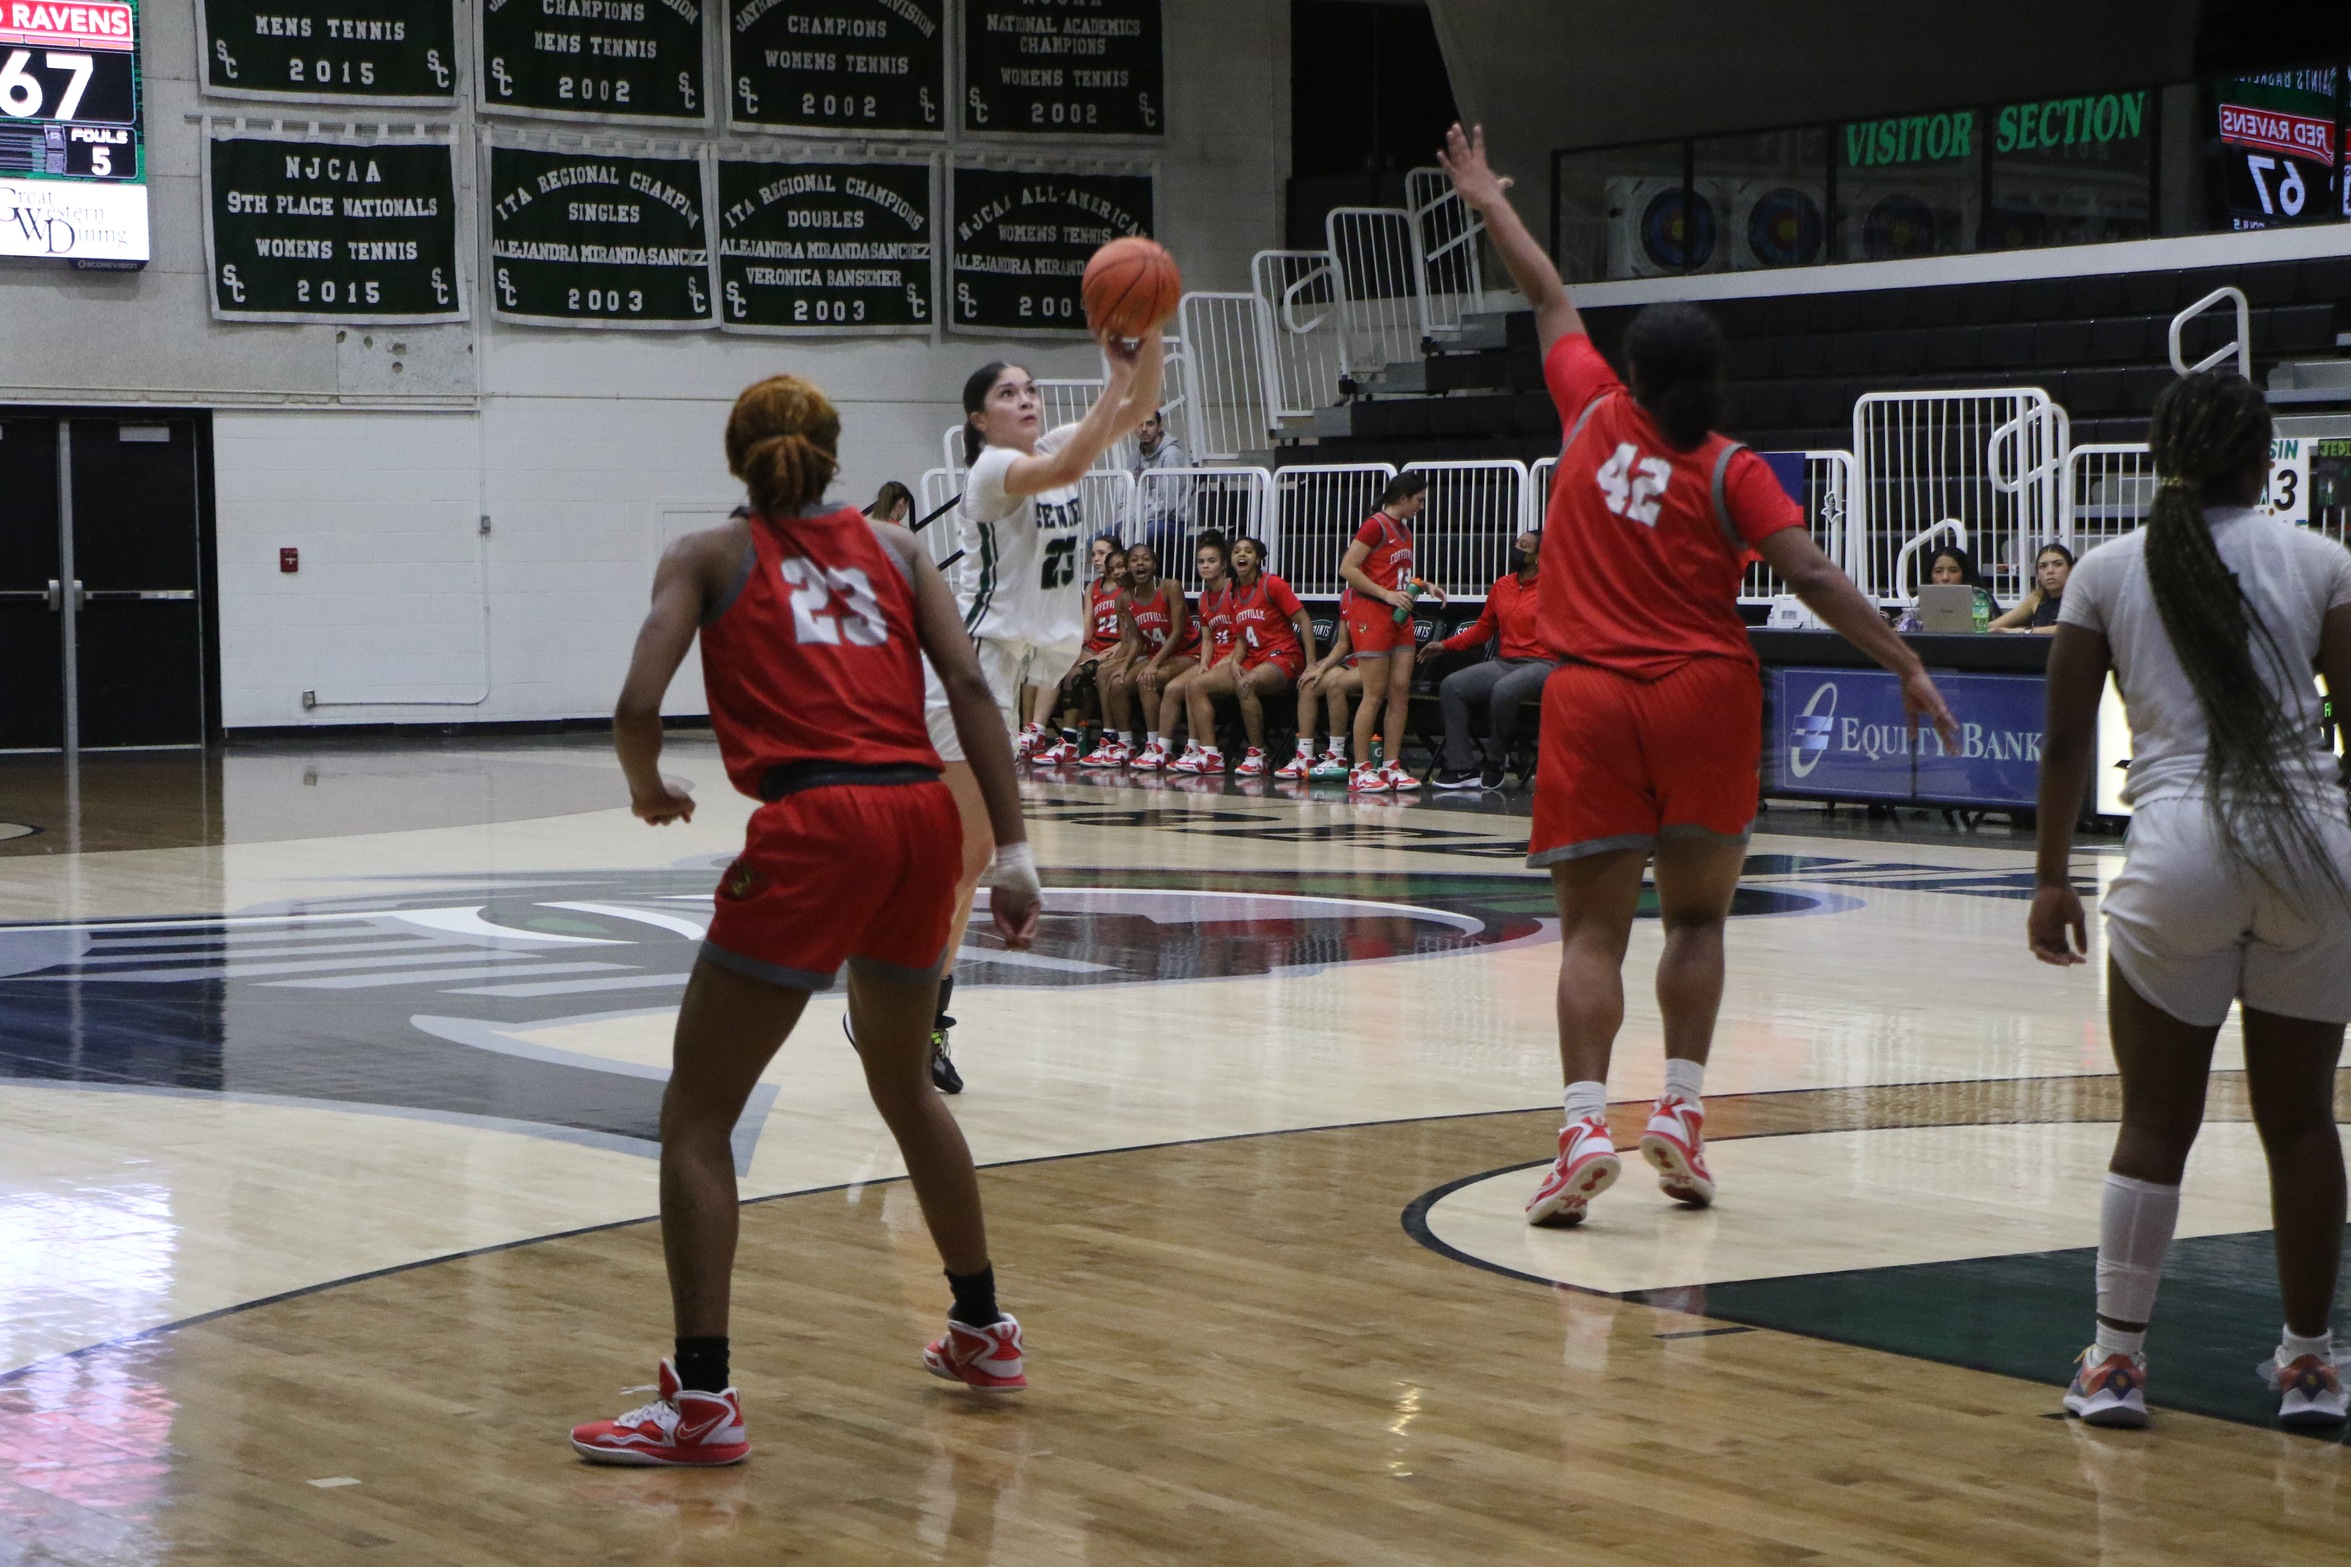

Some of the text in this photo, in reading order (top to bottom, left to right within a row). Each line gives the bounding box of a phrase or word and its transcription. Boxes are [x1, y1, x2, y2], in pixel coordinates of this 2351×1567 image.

[12, 3, 128, 35] RAVENS
[542, 0, 645, 22] CHAMPIONS
[255, 15, 405, 41] MENS TENNIS
[787, 15, 887, 38] CHAMPIONS
[986, 14, 1141, 37] NATIONAL ACADEMICS
[534, 30, 657, 59] MENS TENNIS
[1020, 36, 1106, 55] CHAMPIONS
[289, 58, 375, 85] 2015
[764, 50, 909, 75] WOMENS TENNIS
[0, 50, 93, 120] 67
[1000, 67, 1129, 88] WOMENS TENNIS
[559, 76, 630, 103] 2002
[802, 93, 876, 117] 2002
[1031, 102, 1097, 125] 2002
[70, 127, 128, 144] FOULS
[1846, 91, 2145, 167] VISITOR SECTION
[91, 146, 111, 176] 5
[285, 155, 381, 183] NJCAA
[227, 191, 438, 218] 9TH PLACE NATIONALS
[495, 186, 533, 221] ITA
[536, 165, 620, 194] REGIONAL
[724, 174, 924, 231] ITA REGIONAL CHAMPIONS
[568, 202, 640, 223] SINGLES
[787, 210, 864, 228] DOUBLES
[45, 217, 128, 254] Dining
[998, 224, 1112, 244] WOMENS TENNIS
[255, 238, 418, 261] WOMENS TENNIS
[492, 239, 579, 262] ALEJANDRA
[719, 238, 805, 260] ALEJANDRA
[953, 254, 1033, 275] ALEJANDRA
[745, 266, 902, 288] VERONICA BANSEMER
[297, 279, 380, 304] 2015
[568, 288, 643, 311] 2003
[794, 300, 865, 321] 2003
[1019, 296, 1086, 317] 200
[1596, 442, 1673, 528] 42
[781, 556, 889, 646] 23
[1245, 625, 1259, 647] 4
[1840, 717, 2043, 762] EQUITY BANK
